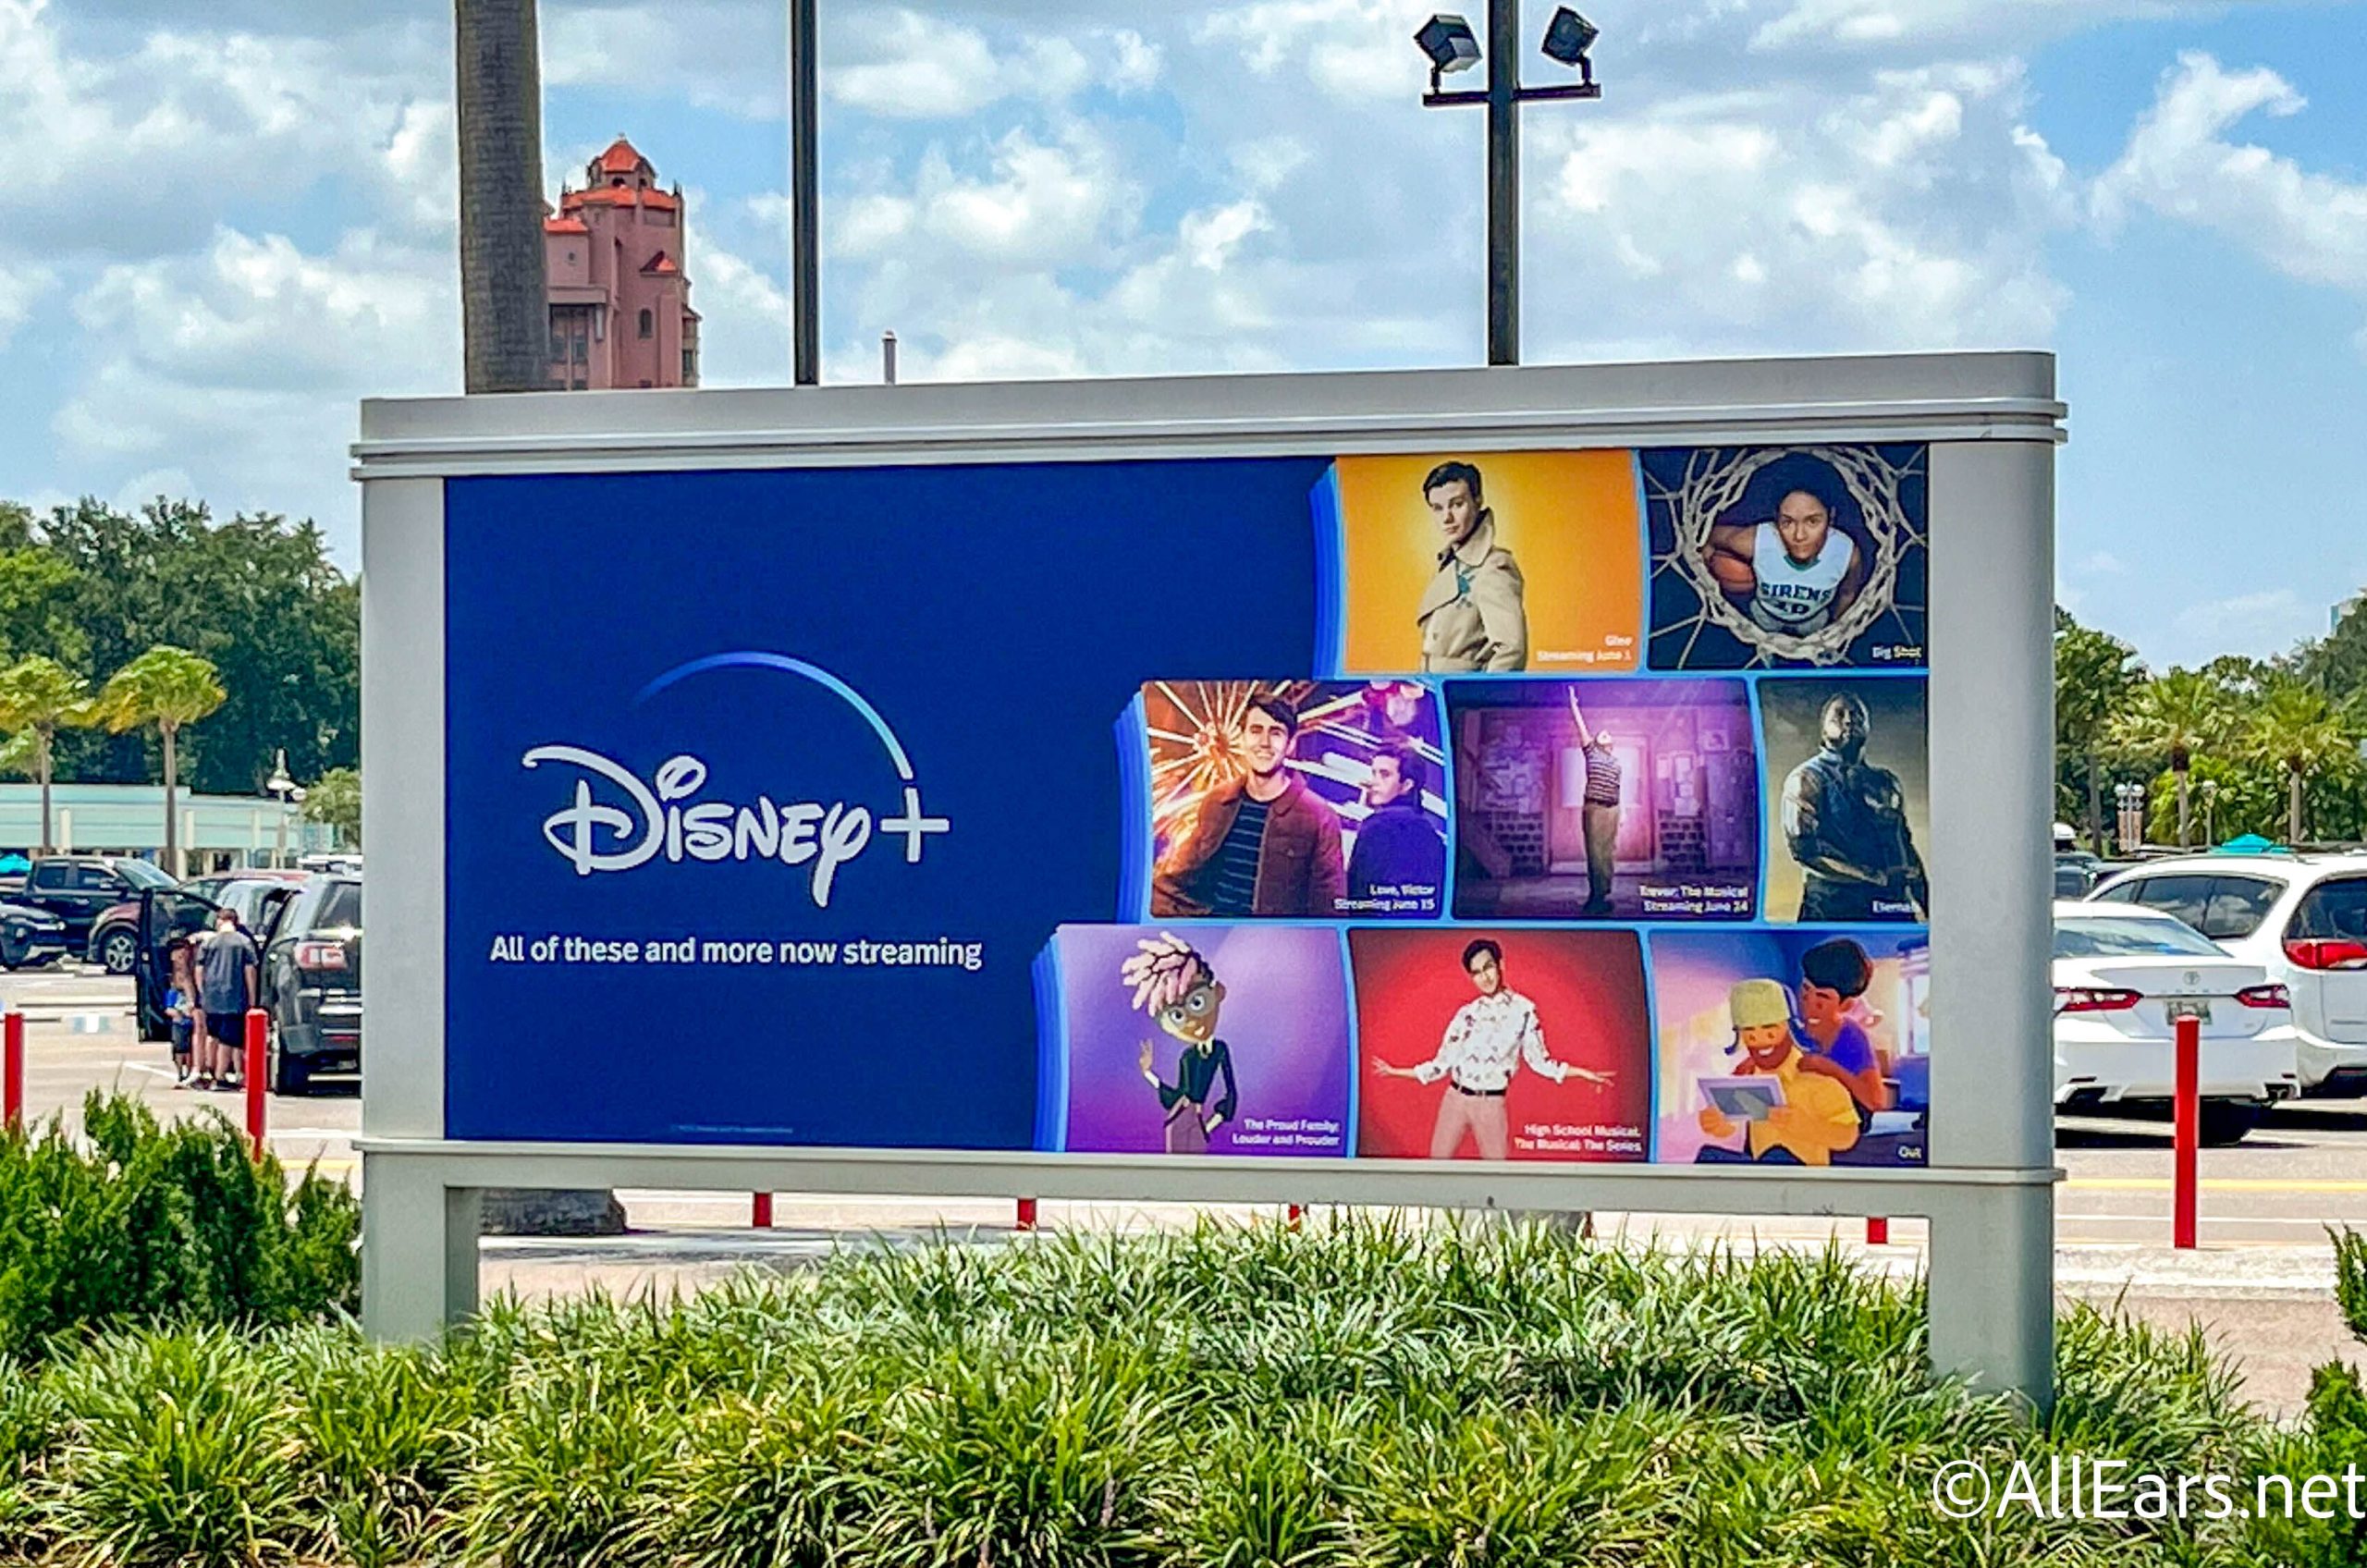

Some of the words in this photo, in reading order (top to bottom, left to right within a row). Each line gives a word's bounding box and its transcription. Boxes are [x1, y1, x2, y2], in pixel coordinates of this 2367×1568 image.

[1760, 582, 1833, 605] SIRENS
[1536, 650, 1595, 664] Streaming
[1596, 650, 1623, 661] June
[1871, 646, 1892, 659] Big
[1894, 646, 1922, 658] Shot
[1400, 883, 1435, 897] Victor
[1680, 885, 1702, 898] The
[1703, 885, 1748, 899] Musical
[1333, 898, 1392, 912] Streaming
[1392, 898, 1418, 911] June
[1420, 898, 1435, 912] 15
[1643, 900, 1704, 914] Streaming
[1704, 900, 1731, 913] June
[1733, 900, 1748, 913] 24
[490, 936, 523, 962] All
[530, 935, 559, 962] of
[563, 936, 639, 963] these
[644, 936, 695, 964] and
[702, 941, 773, 964] more
[779, 941, 837, 965] now
[842, 936, 982, 970] streaming
[1245, 1118, 1264, 1131] The
[1265, 1119, 1299, 1132] Proud
[1524, 1123, 1551, 1138] High
[1552, 1124, 1593, 1136] School
[1232, 1133, 1271, 1145] Louder
[1272, 1134, 1294, 1145] and
[1295, 1134, 1340, 1146] Prouder
[1514, 1136, 1535, 1150] The
[1584, 1139, 1605, 1151] The
[1606, 1139, 1642, 1152] Series
[1898, 1145, 1922, 1159] Out
